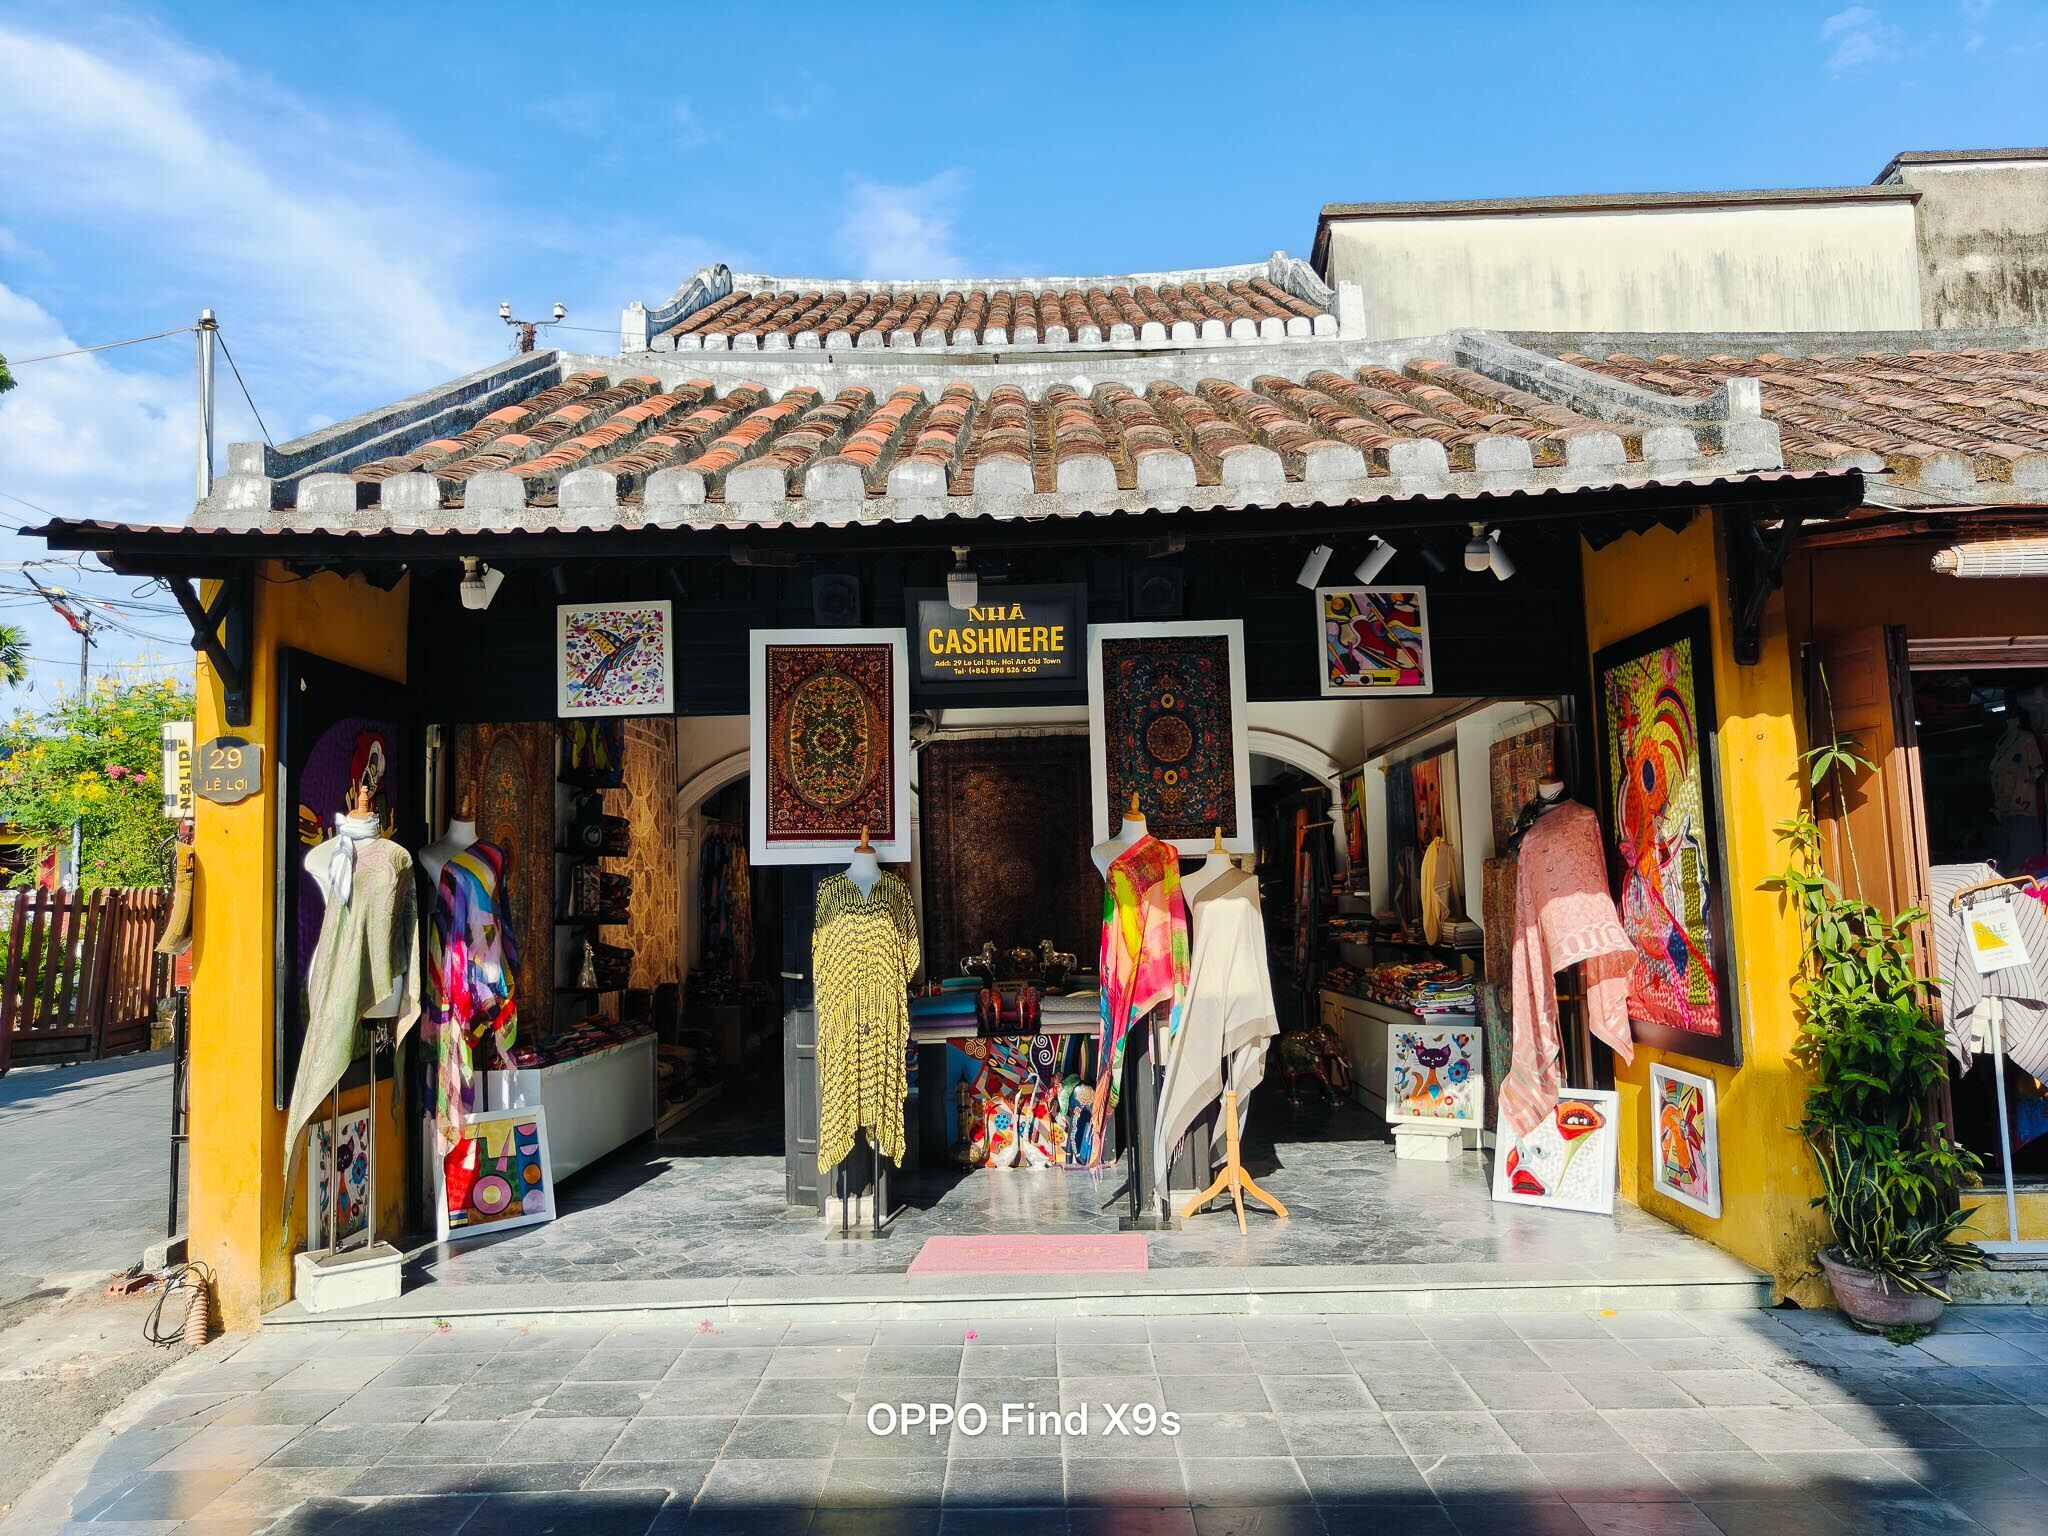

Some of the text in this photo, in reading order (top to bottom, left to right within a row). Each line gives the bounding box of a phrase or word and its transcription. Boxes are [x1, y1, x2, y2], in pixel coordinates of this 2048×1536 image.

[927, 626, 1064, 654] CASHMERE
[1043, 657, 1061, 665] Town
[968, 667, 989, 675] (+84)
[1022, 665, 1037, 673] 450
[209, 748, 242, 769] 29
[205, 777, 248, 792] LÊ LỢI
[1976, 922, 2008, 936] SALE
